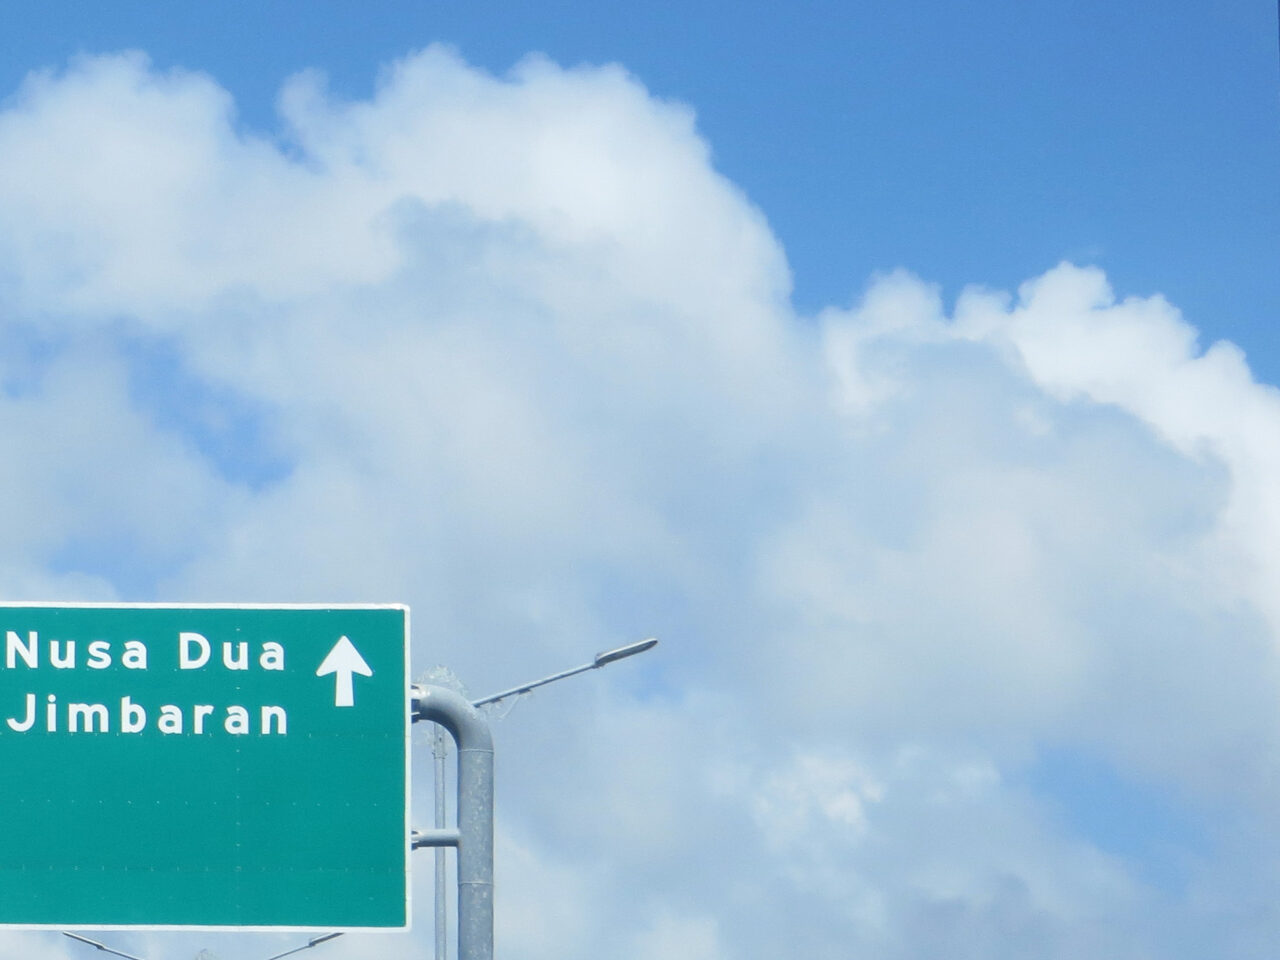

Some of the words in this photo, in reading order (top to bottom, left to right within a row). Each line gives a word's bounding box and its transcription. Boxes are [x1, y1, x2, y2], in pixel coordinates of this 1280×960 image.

[6, 630, 147, 670] Nusa
[179, 631, 285, 671] Dua
[6, 693, 287, 735] Jimbaran
